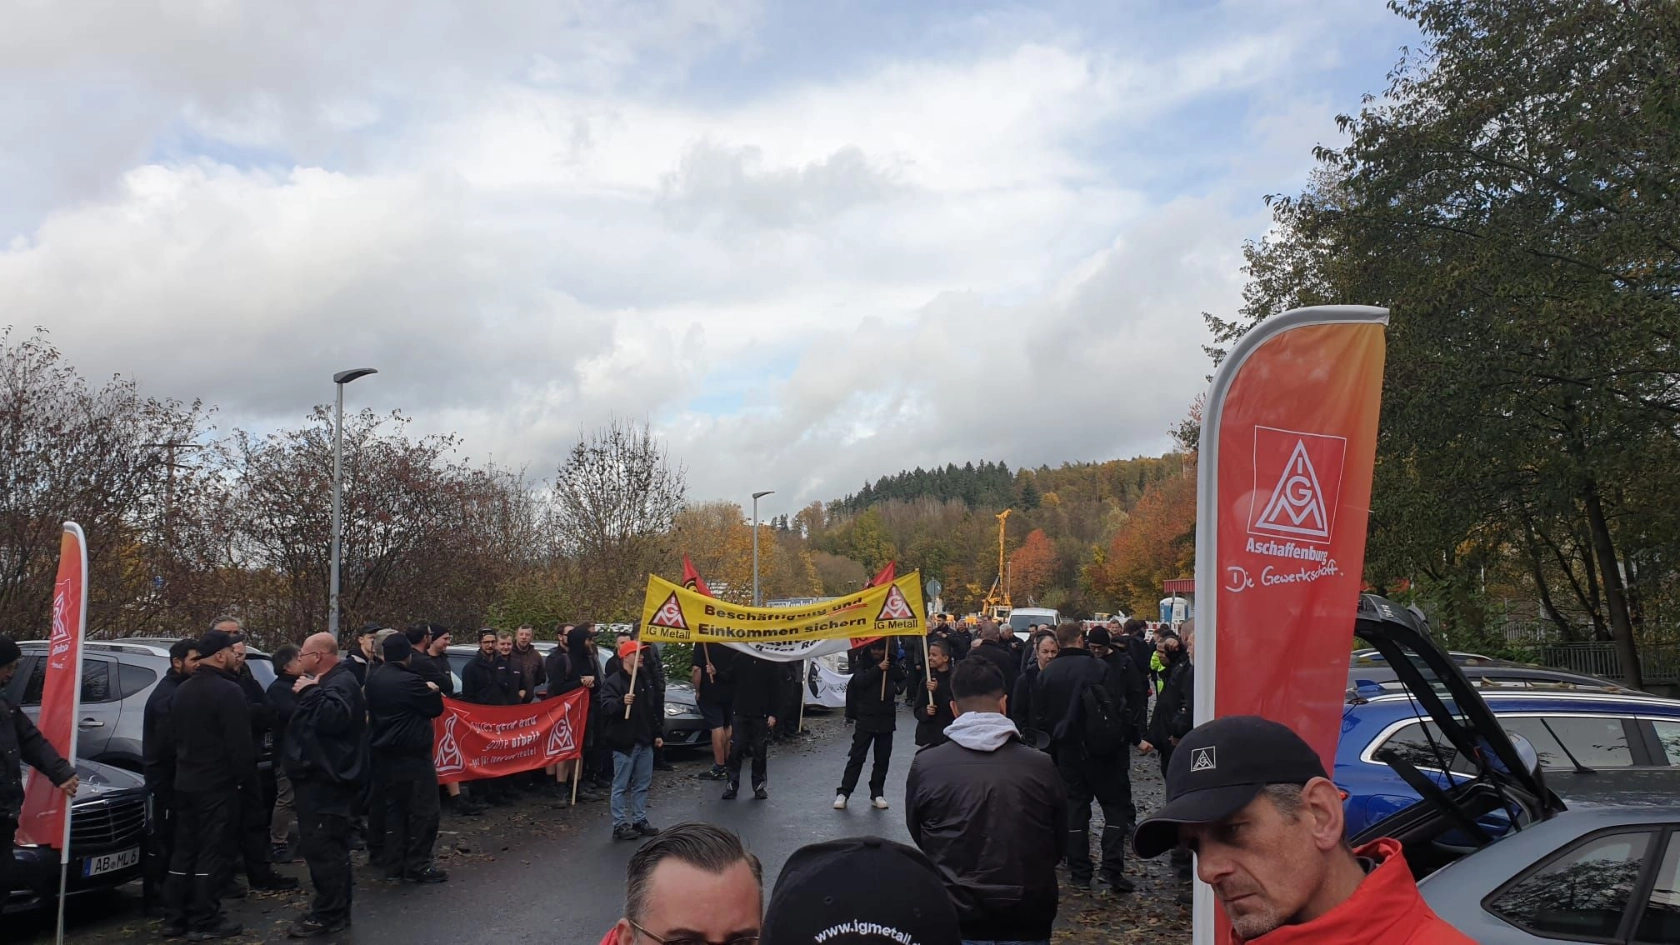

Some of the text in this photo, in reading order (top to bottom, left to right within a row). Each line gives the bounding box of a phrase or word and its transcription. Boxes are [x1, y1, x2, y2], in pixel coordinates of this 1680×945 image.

[1246, 537, 1328, 565] Aschaffenburg
[1225, 566, 1254, 592] Die
[646, 626, 691, 640] IG Metall
[698, 617, 867, 638] Einkommen sichern
[874, 619, 918, 630] IG Metall
[94, 857, 110, 873] AB
[814, 918, 922, 945] www.igmetall.
